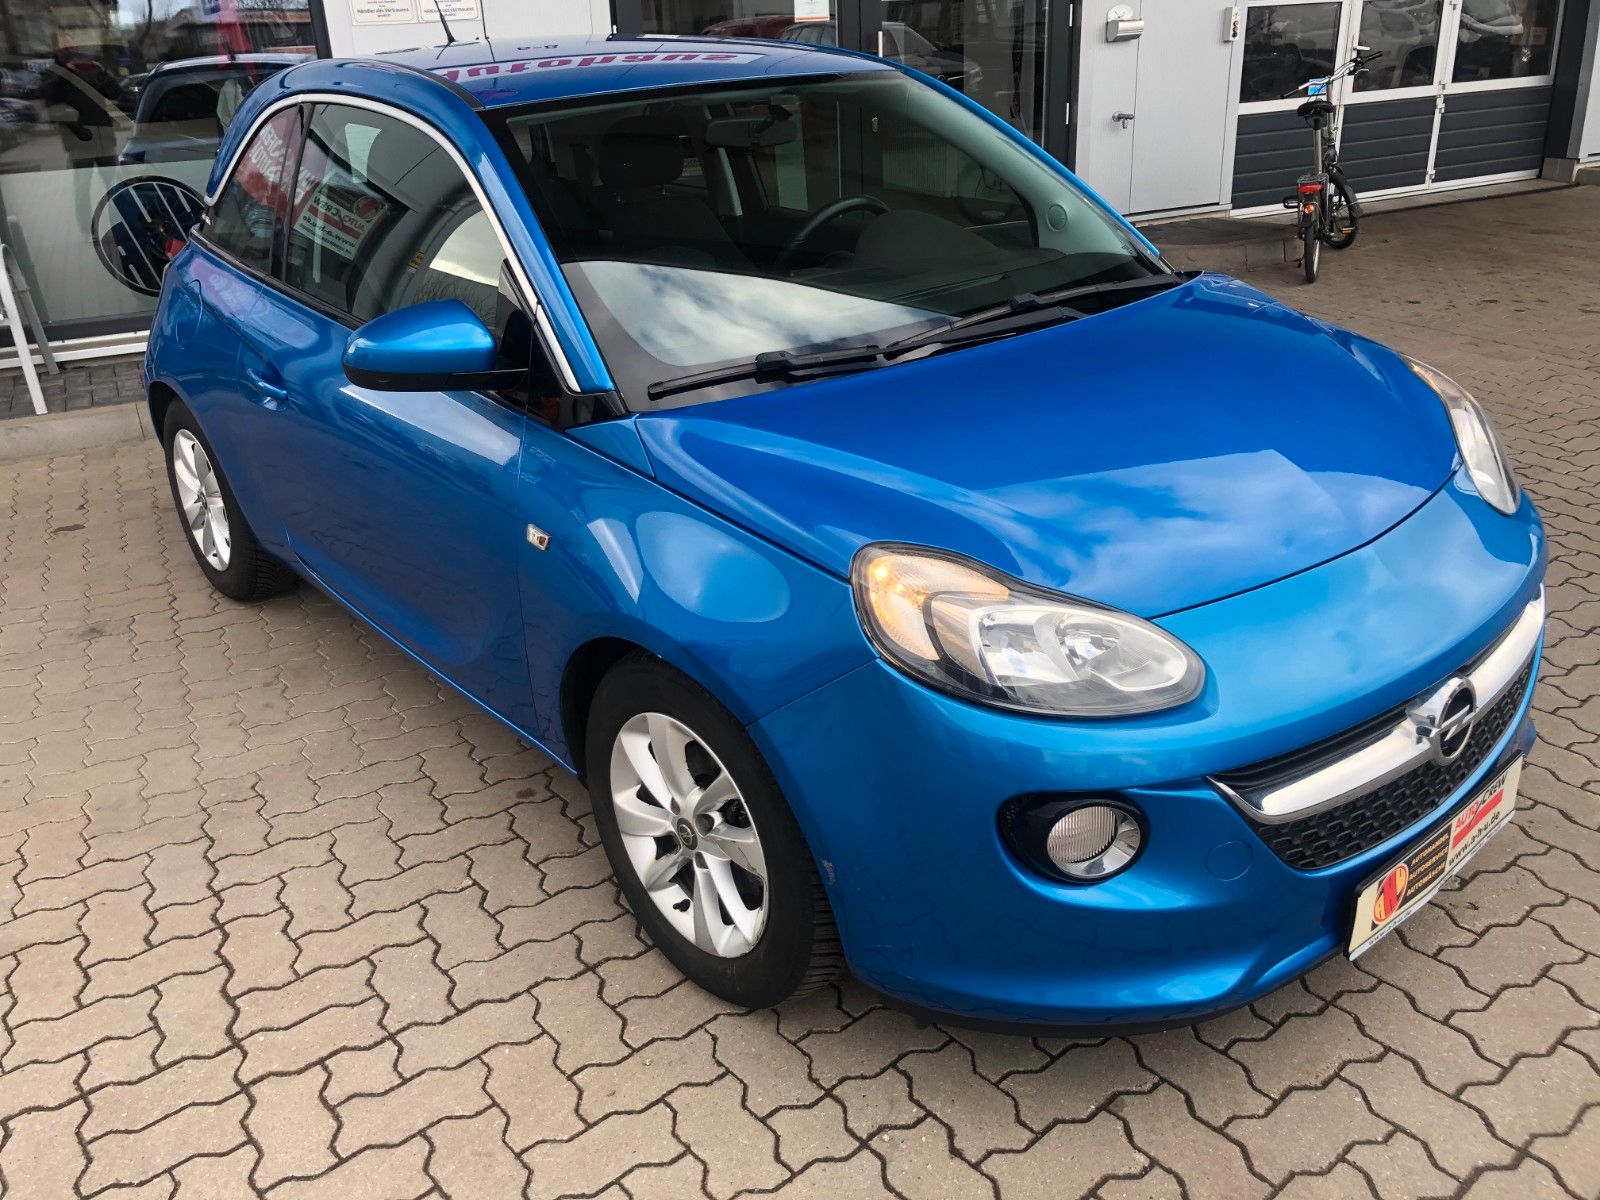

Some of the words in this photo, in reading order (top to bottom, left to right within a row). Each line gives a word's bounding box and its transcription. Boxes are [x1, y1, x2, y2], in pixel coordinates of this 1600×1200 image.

[1411, 832, 1449, 866] AUTOHANDEL
[1449, 811, 1500, 866] www.a-h-u.de
[1409, 846, 1449, 880] AUTOSERVICE
